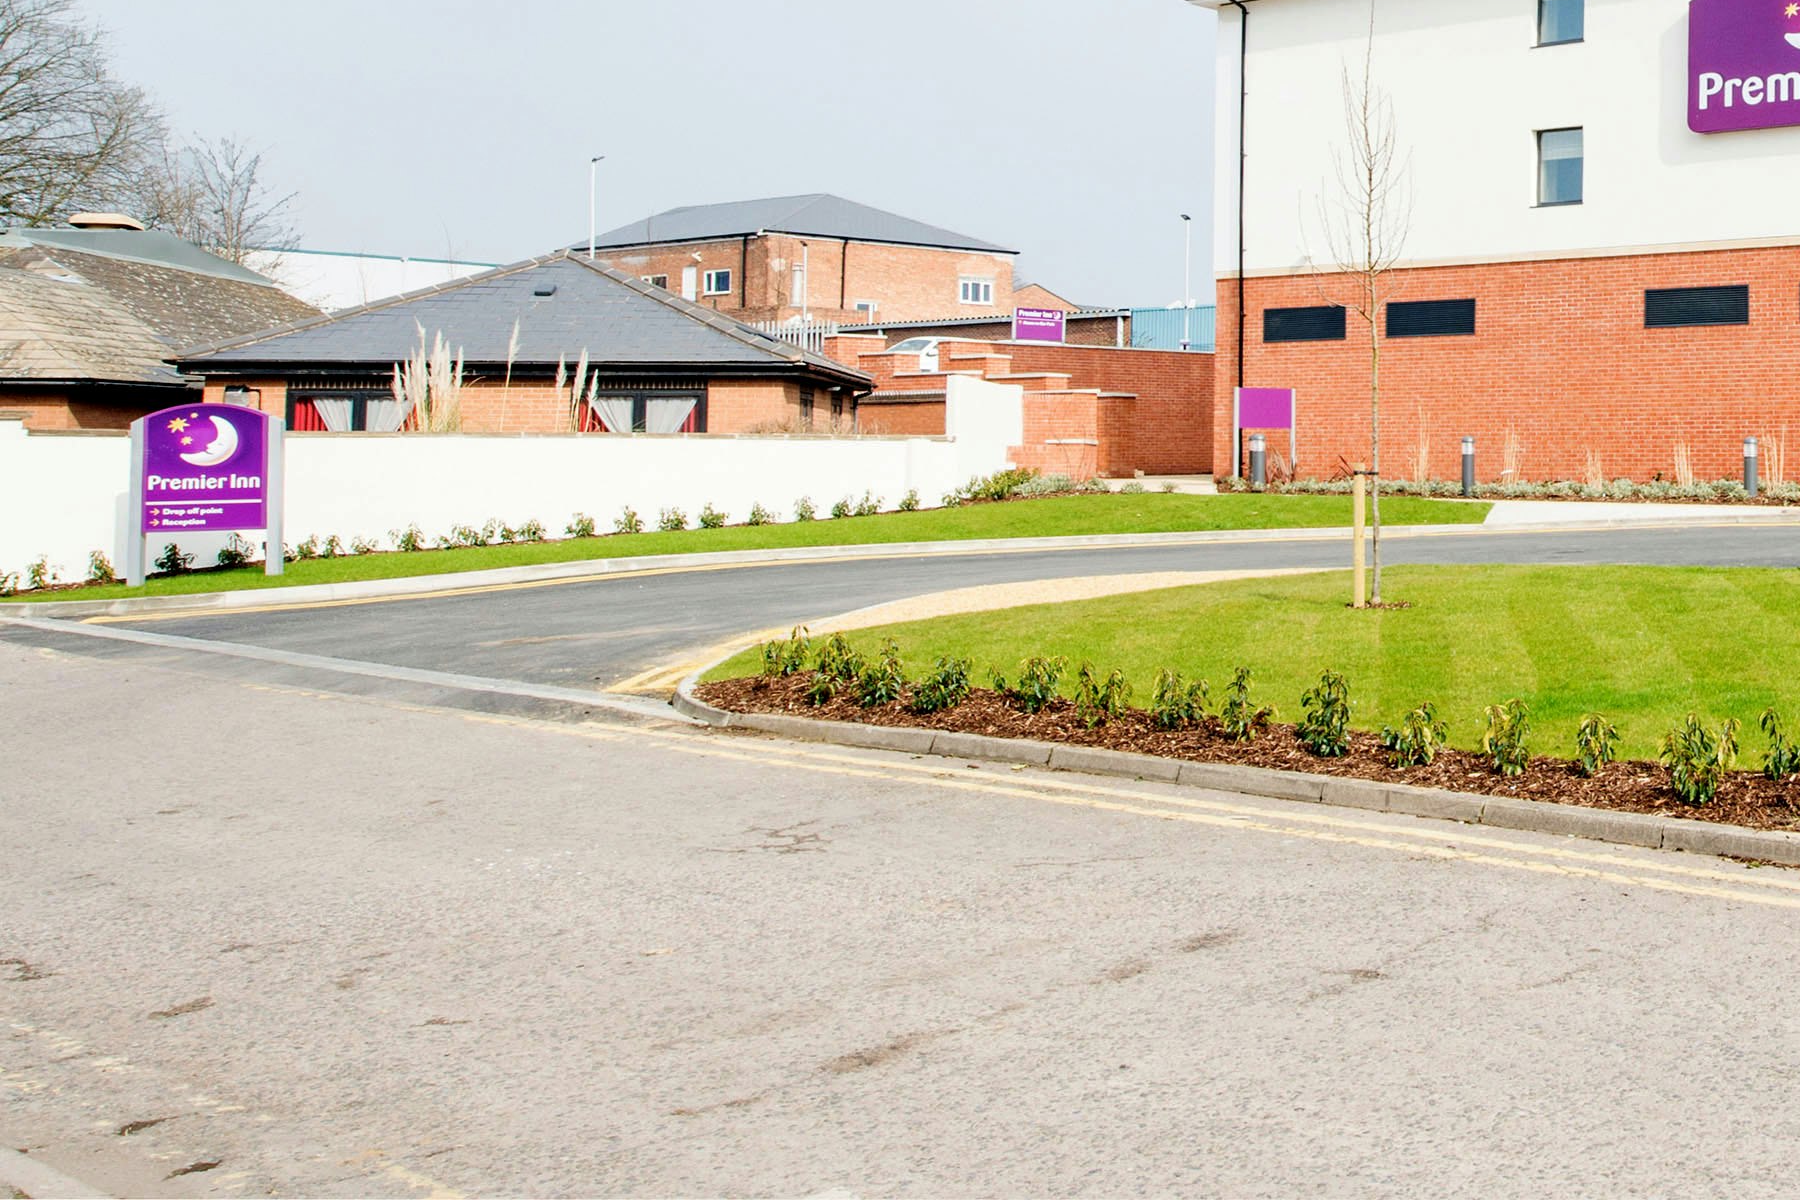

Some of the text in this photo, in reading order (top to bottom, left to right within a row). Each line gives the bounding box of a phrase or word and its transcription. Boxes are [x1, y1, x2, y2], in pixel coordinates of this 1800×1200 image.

[147, 474, 261, 491] Premier Inn
[162, 507, 224, 517] Drop off point
[162, 518, 206, 527] Reception
